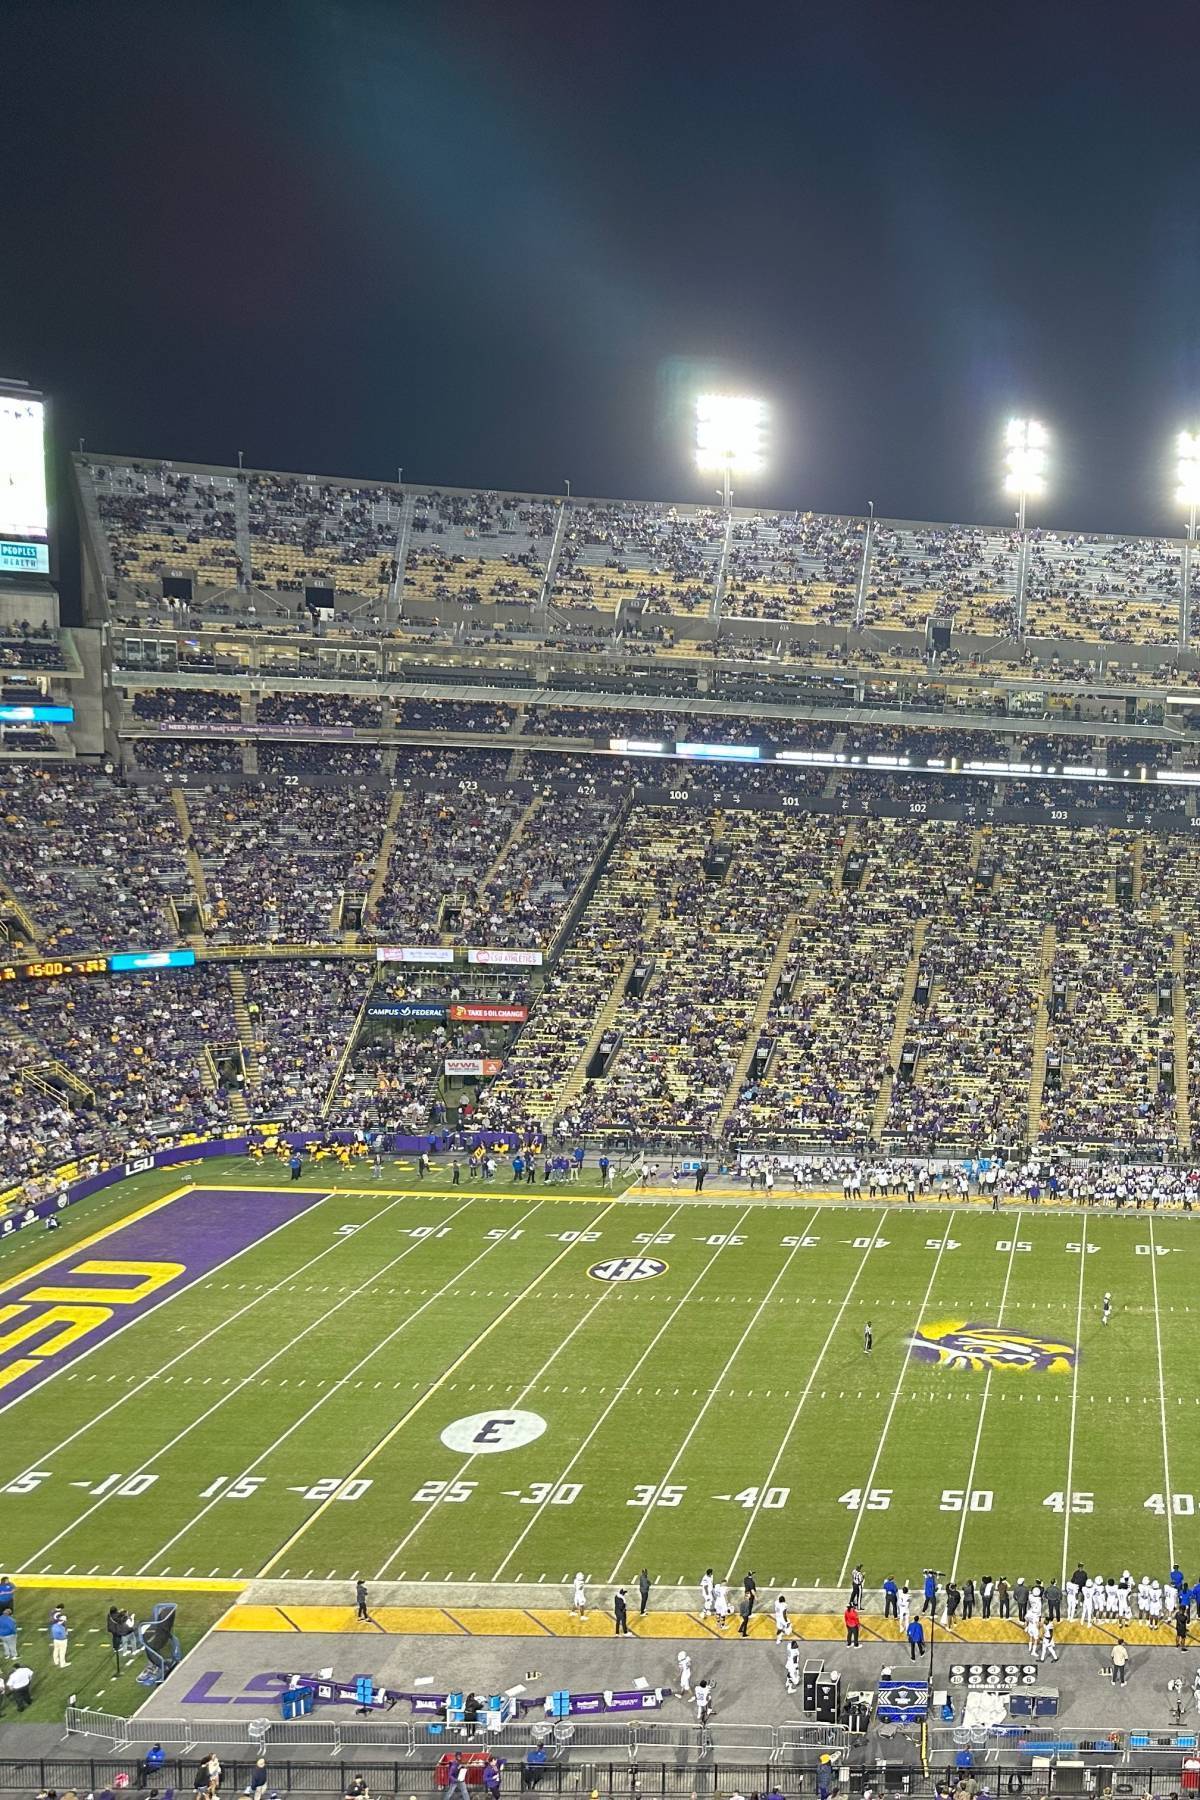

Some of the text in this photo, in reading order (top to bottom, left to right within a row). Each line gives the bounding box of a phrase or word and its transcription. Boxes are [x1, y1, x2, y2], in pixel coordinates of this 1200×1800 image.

[3, 545, 36, 557] PEOPLES
[458, 780, 478, 790] 423
[577, 786, 596, 796] 424
[669, 791, 688, 800] 100
[782, 797, 800, 806] 101
[909, 803, 926, 813] 102
[1051, 810, 1068, 820] 103
[504, 954, 537, 964] ATHLETICS
[28, 962, 63, 977] 15:00
[368, 1008, 443, 1017] CAMPUS FEDERAL
[125, 1155, 155, 1177] LSU
[334, 1224, 360, 1235] 5
[408, 1226, 452, 1238] 10
[483, 1229, 525, 1241] 15
[558, 1231, 603, 1242] 20
[632, 1233, 677, 1244] 25
[706, 1234, 749, 1246] 30
[780, 1236, 821, 1247] 35
[852, 1237, 892, 1249] 40
[924, 1239, 962, 1251] 45
[995, 1240, 1033, 1252] 50
[1065, 1242, 1101, 1254] 45
[1135, 1244, 1170, 1256] 40
[5, 1471, 52, 1493] 5
[88, 1473, 159, 1495] 10
[200, 1476, 267, 1498] 15
[303, 1478, 374, 1500] 20
[411, 1480, 479, 1502] 25
[519, 1482, 584, 1504] 30
[626, 1485, 687, 1507] 35
[733, 1487, 791, 1509] 40
[837, 1488, 893, 1510] 45
[939, 1490, 993, 1512] 50
[1042, 1491, 1094, 1513] 45
[1143, 1493, 1195, 1515] 40
